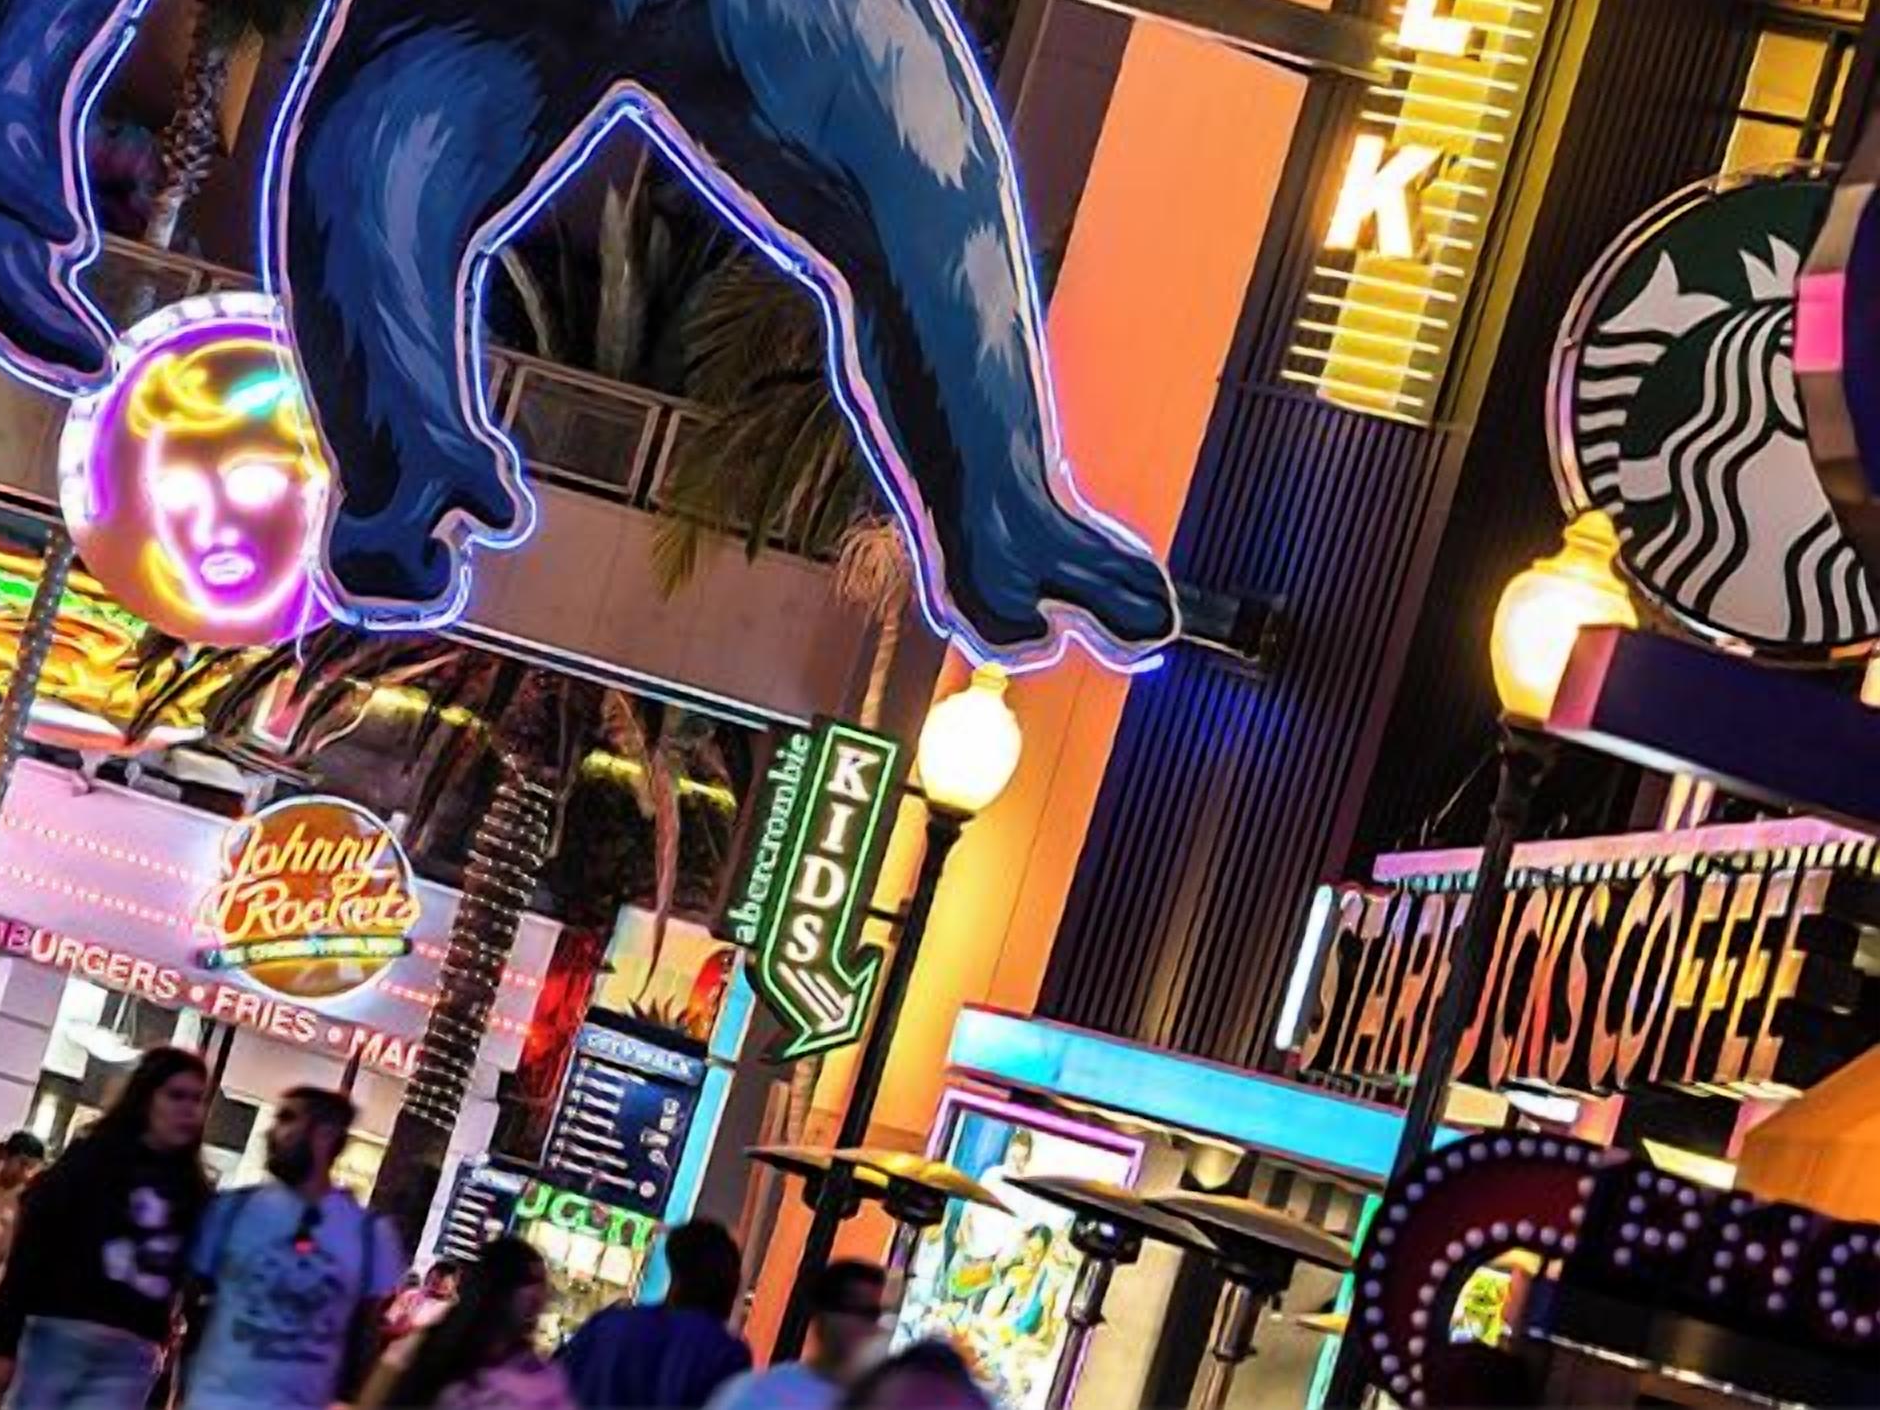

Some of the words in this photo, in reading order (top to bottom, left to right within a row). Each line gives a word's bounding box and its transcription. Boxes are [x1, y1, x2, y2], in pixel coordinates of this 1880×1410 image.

[202, 874, 421, 943] Rockets
[221, 817, 399, 894] Johnny
[728, 733, 812, 943] abercrombie
[785, 745, 880, 963] KIDS
[212, 985, 317, 1043] FRIES
[1589, 869, 1832, 1089] COFFEE
